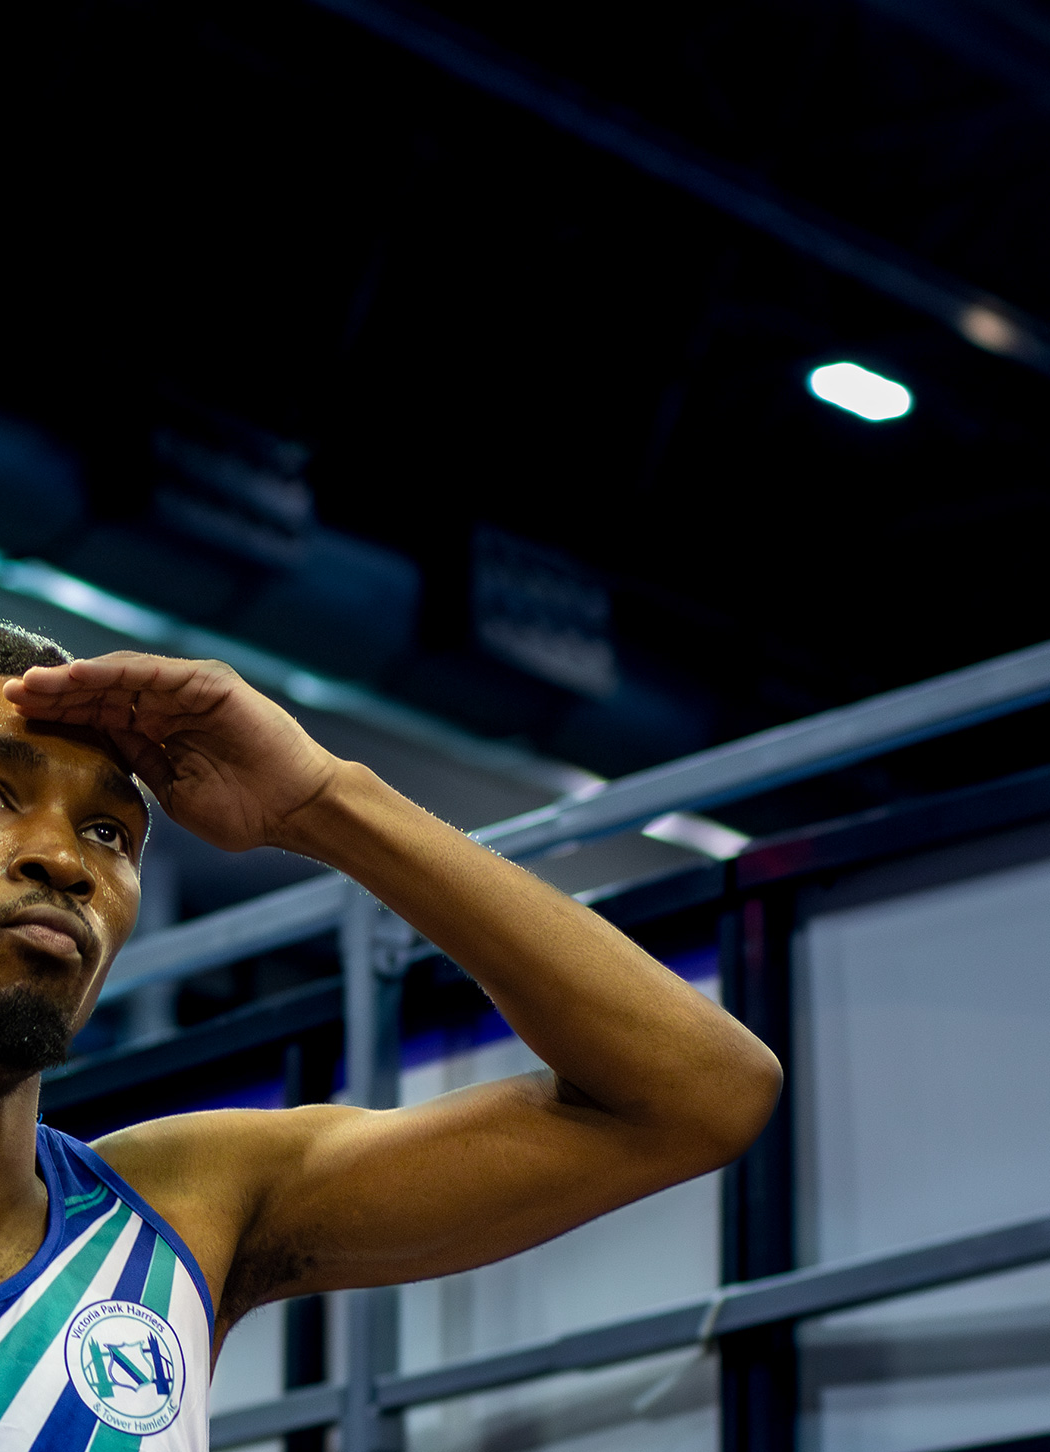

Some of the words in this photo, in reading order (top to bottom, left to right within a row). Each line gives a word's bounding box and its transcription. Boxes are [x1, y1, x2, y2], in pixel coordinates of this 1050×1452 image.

[71, 1310, 101, 1340] Victoria
[100, 1302, 124, 1316] Park
[126, 1305, 166, 1334] Harriers
[93, 1402, 101, 1412] &
[102, 1408, 132, 1430] Tower
[134, 1413, 170, 1432] Hamlets
[168, 1399, 179, 1417] AC
